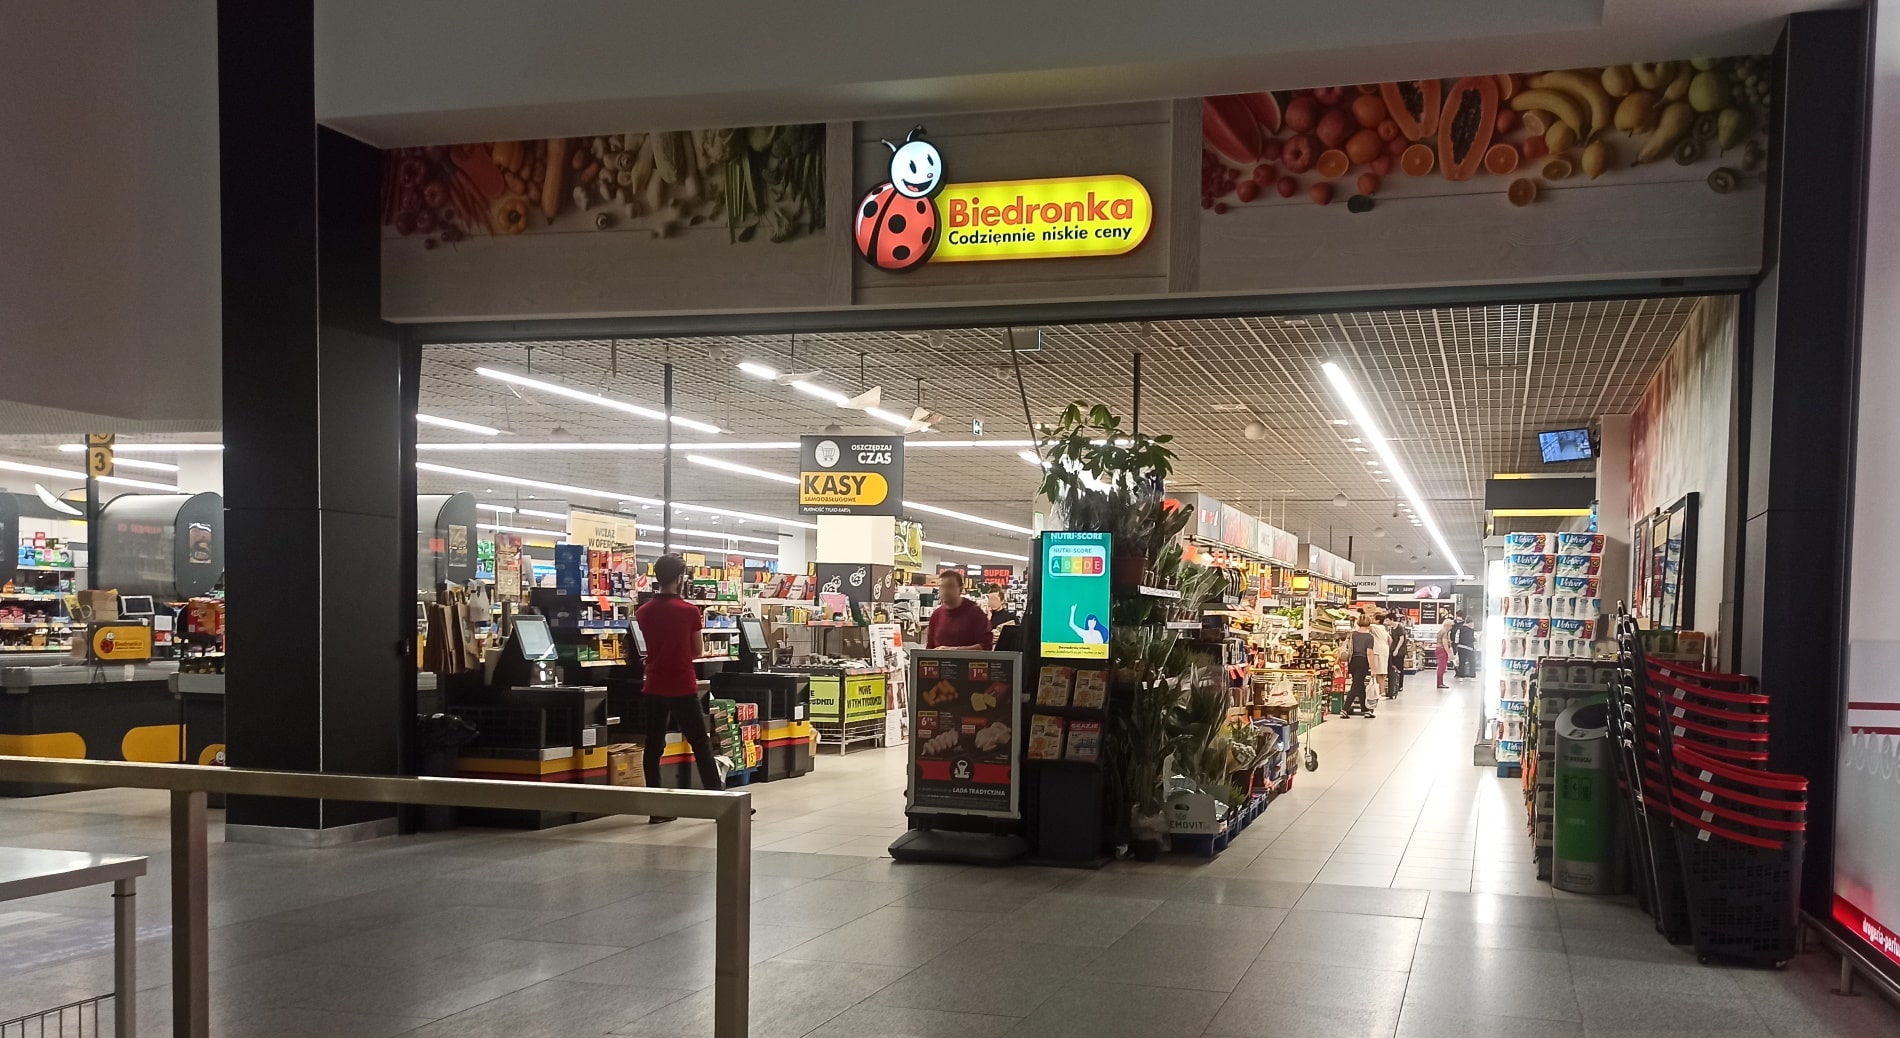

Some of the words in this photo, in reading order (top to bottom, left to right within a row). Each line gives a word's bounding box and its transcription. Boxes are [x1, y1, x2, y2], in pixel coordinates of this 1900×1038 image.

[949, 192, 1134, 228] Biedronka
[949, 230, 1036, 246] Codziennie
[1042, 226, 1089, 241] niskie
[1095, 226, 1133, 241] ceny
[851, 444, 893, 452] OSZCZĘDZAJ
[94, 452, 106, 471] 3
[857, 452, 892, 465] CZAS
[804, 475, 868, 496] KASY
[1050, 532, 1103, 540] NUTRI-SCORE
[588, 537, 595, 547] W
[983, 569, 1010, 577] SUPER
[969, 788, 1005, 796] TRADYCYJNA
